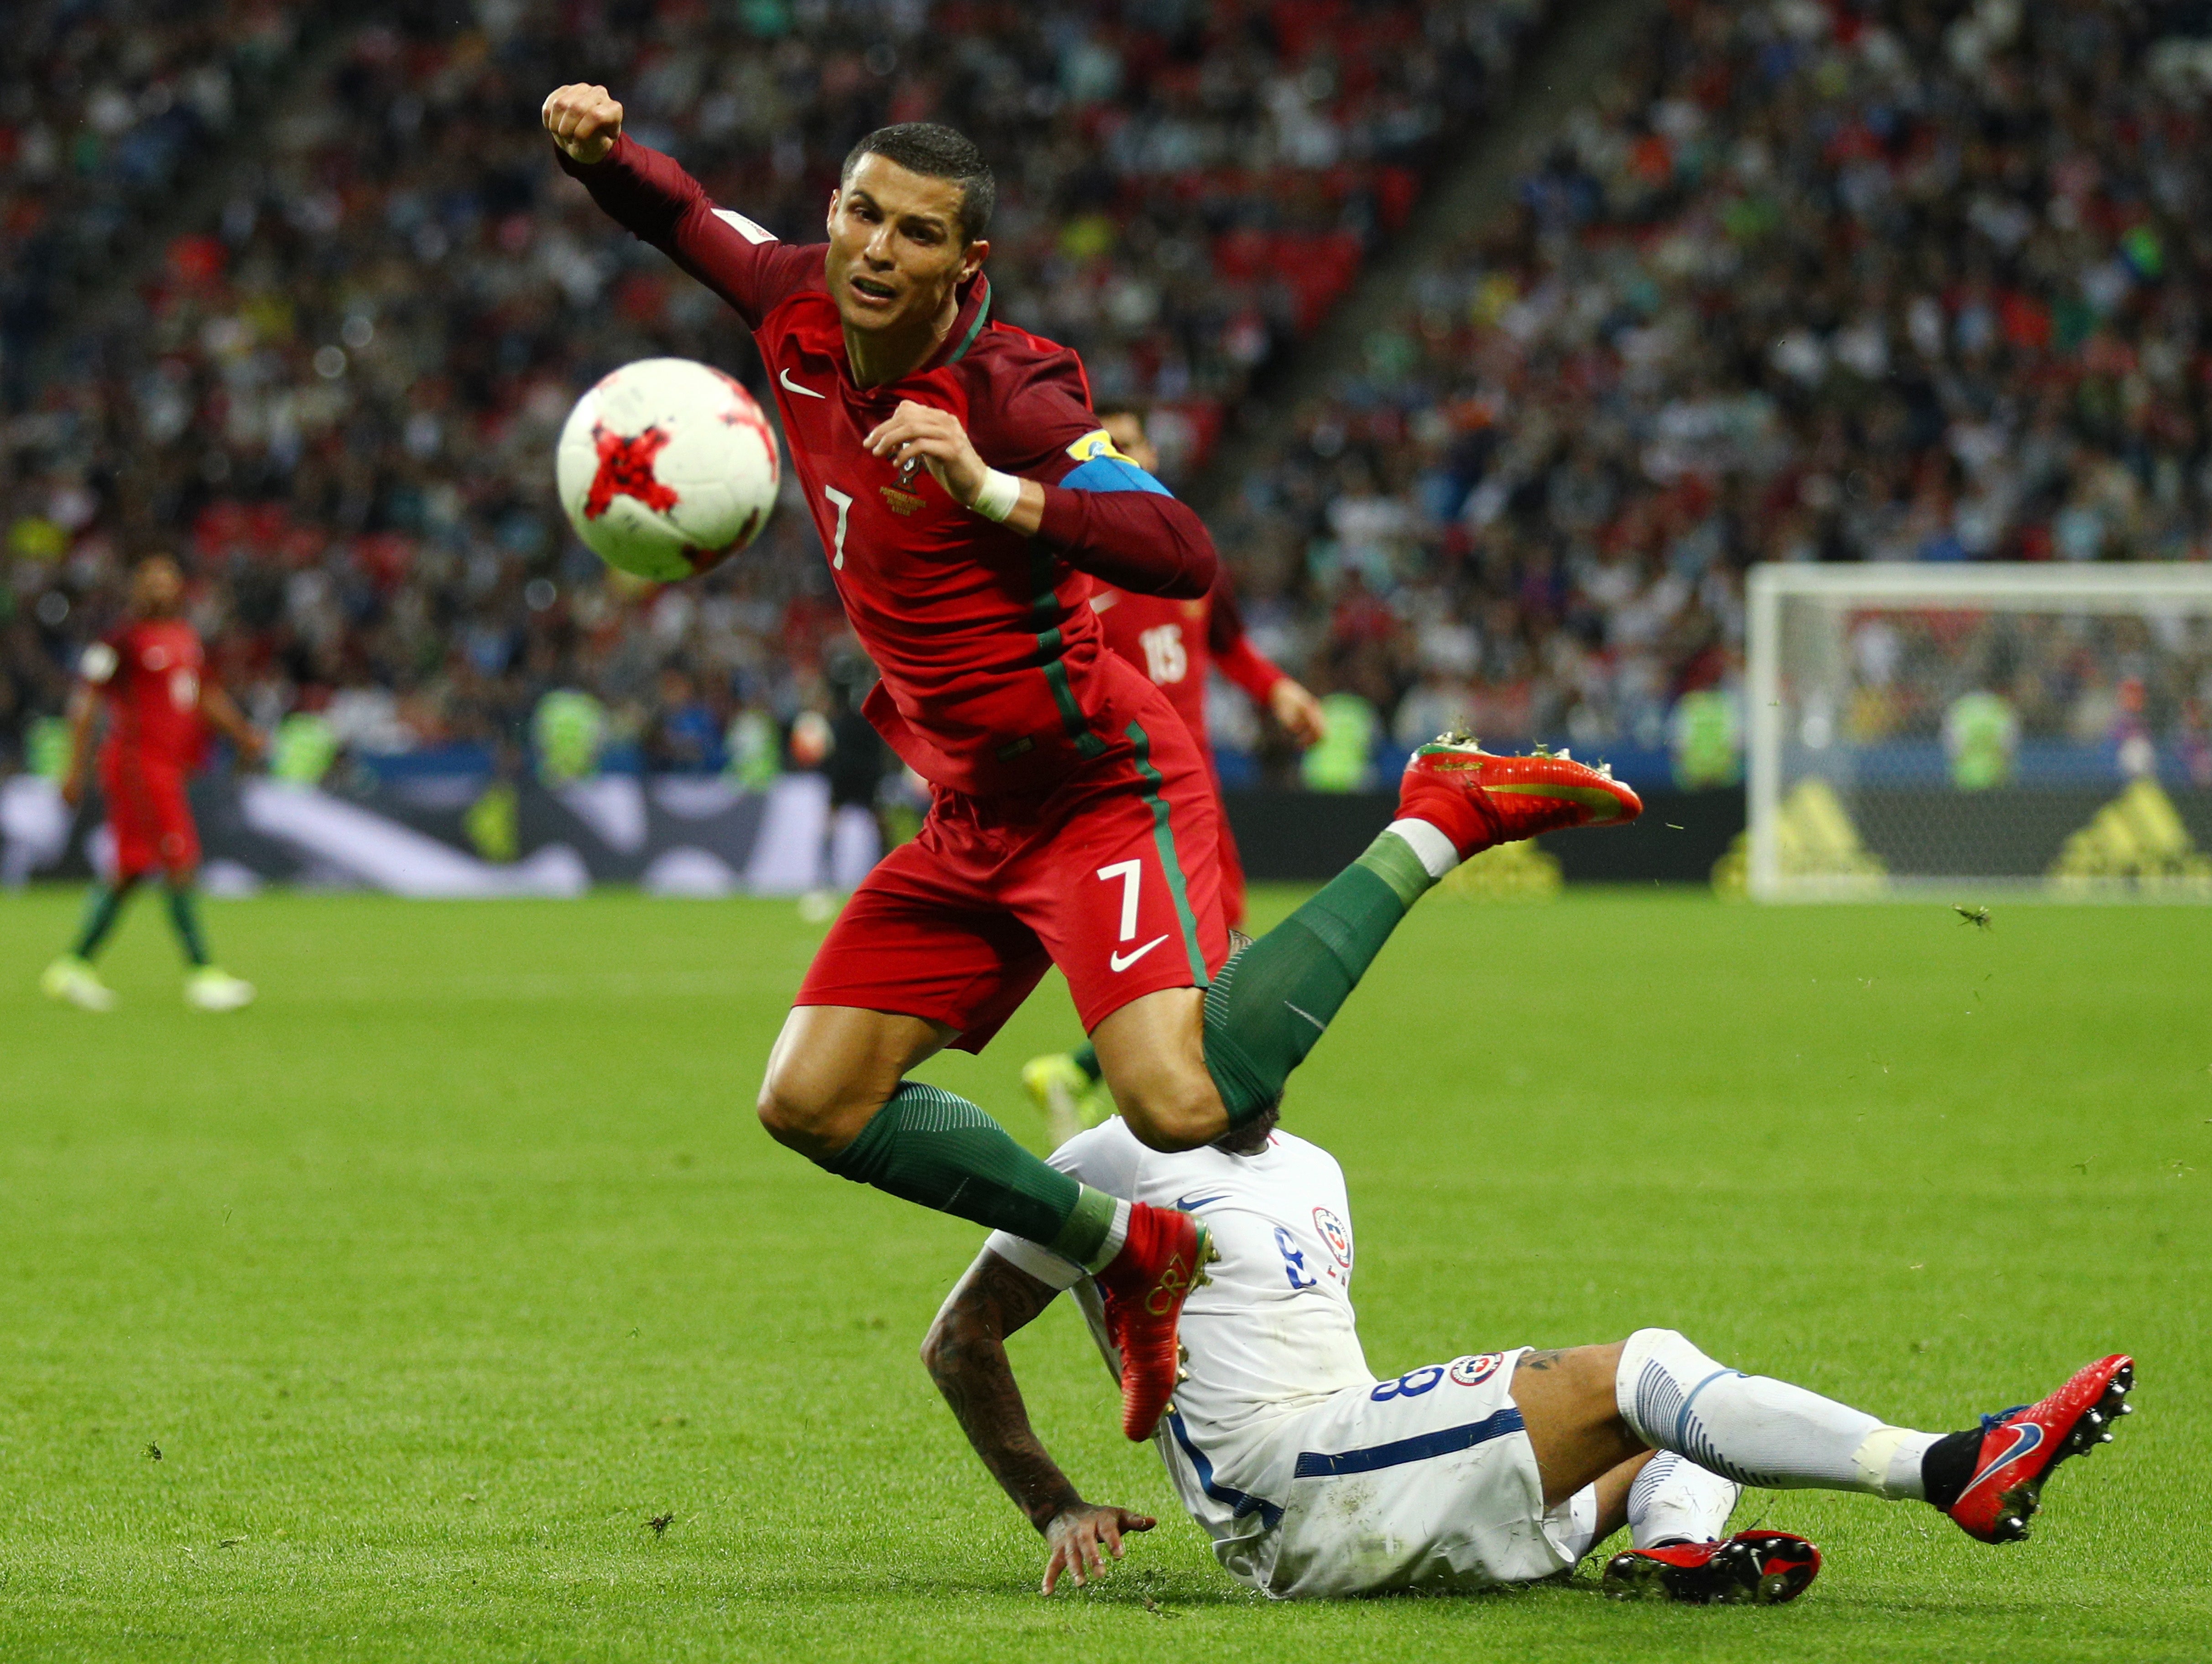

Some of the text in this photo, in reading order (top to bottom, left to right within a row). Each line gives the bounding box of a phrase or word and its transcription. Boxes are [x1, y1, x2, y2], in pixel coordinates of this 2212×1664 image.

[825, 484, 853, 570] 7
[1096, 858, 1141, 942] 7
[1145, 1253, 1190, 1316] CR7
[1370, 1367, 1445, 1402] 8
